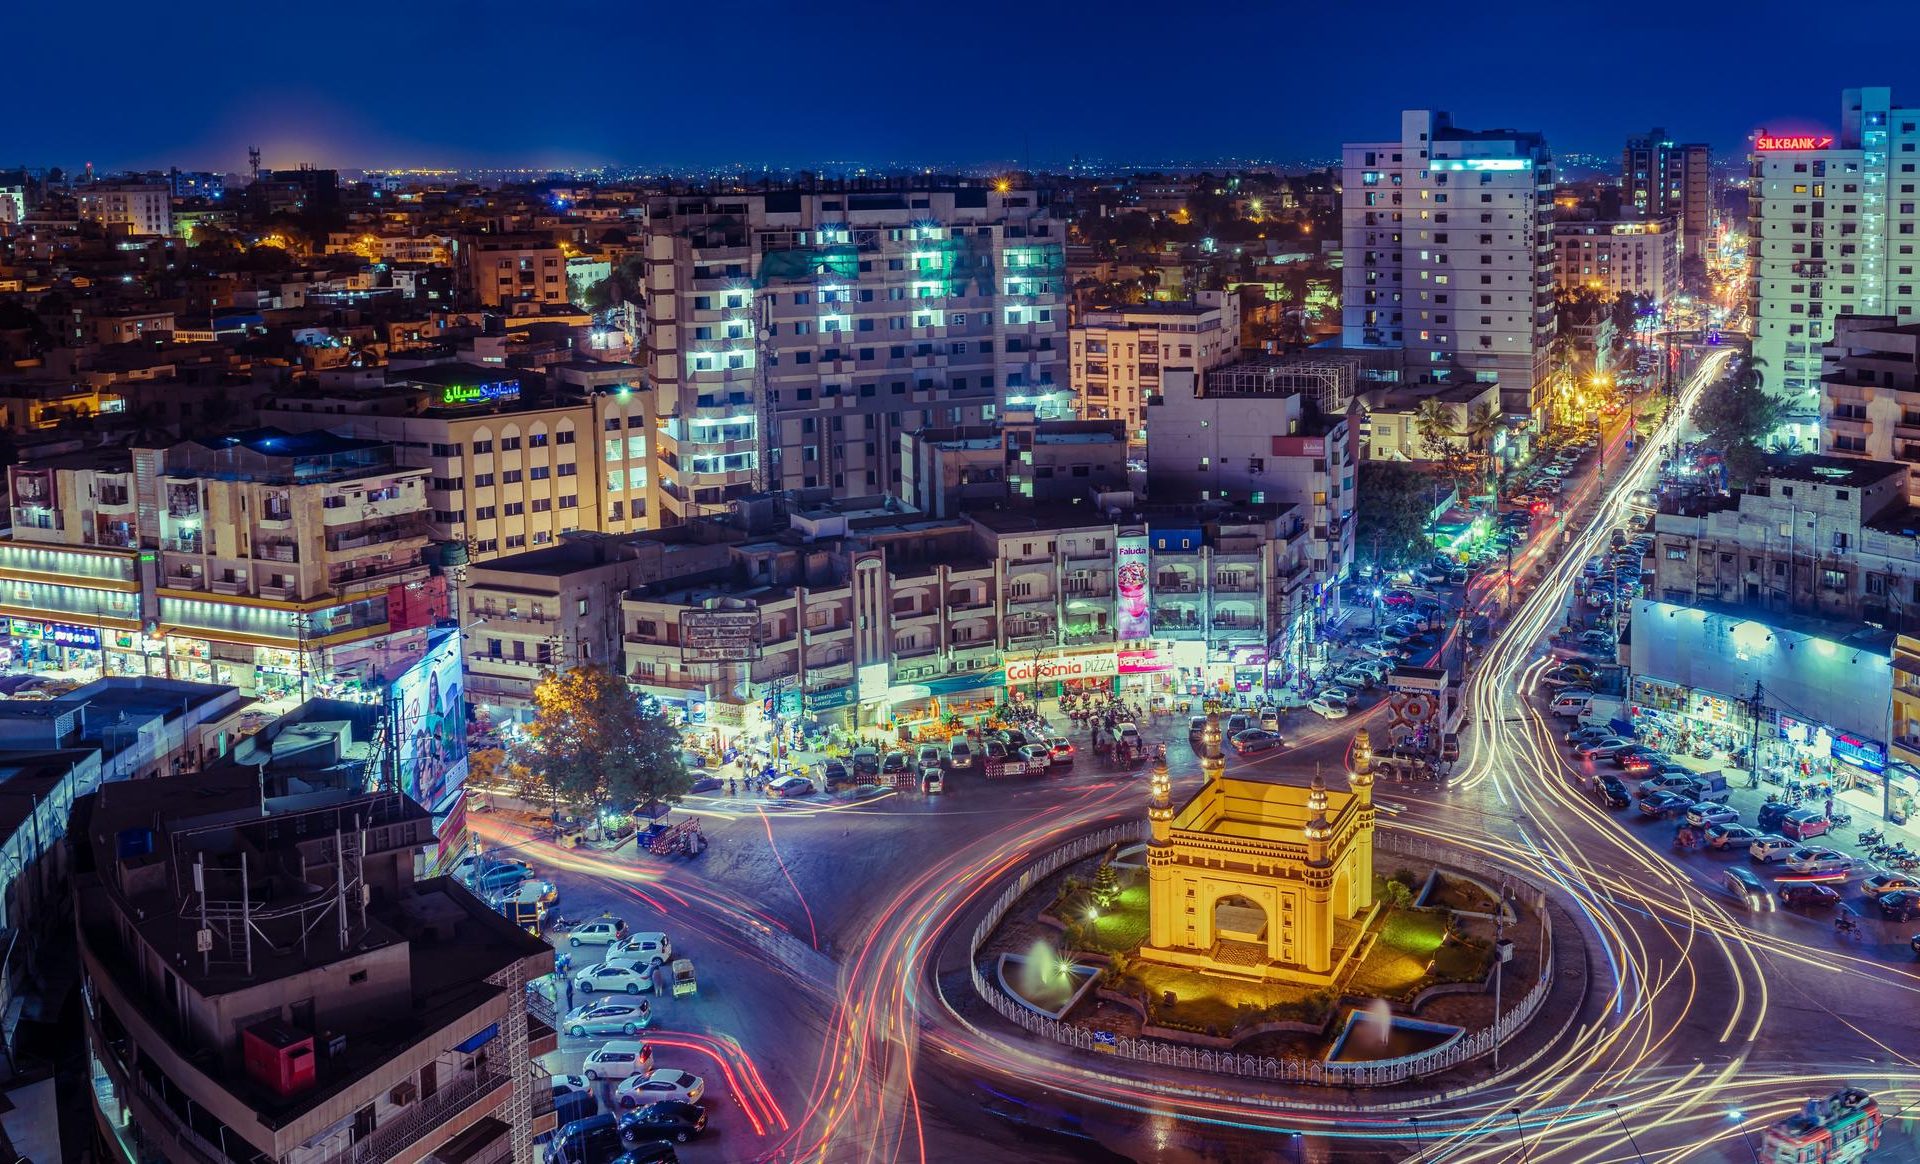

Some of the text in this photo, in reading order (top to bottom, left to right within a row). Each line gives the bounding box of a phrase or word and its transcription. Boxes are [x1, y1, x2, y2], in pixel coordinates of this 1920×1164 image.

[1758, 137, 1815, 149] SILKBANK
[1119, 547, 1147, 555] Faluda
[1085, 657, 1116, 673] PIZZA
